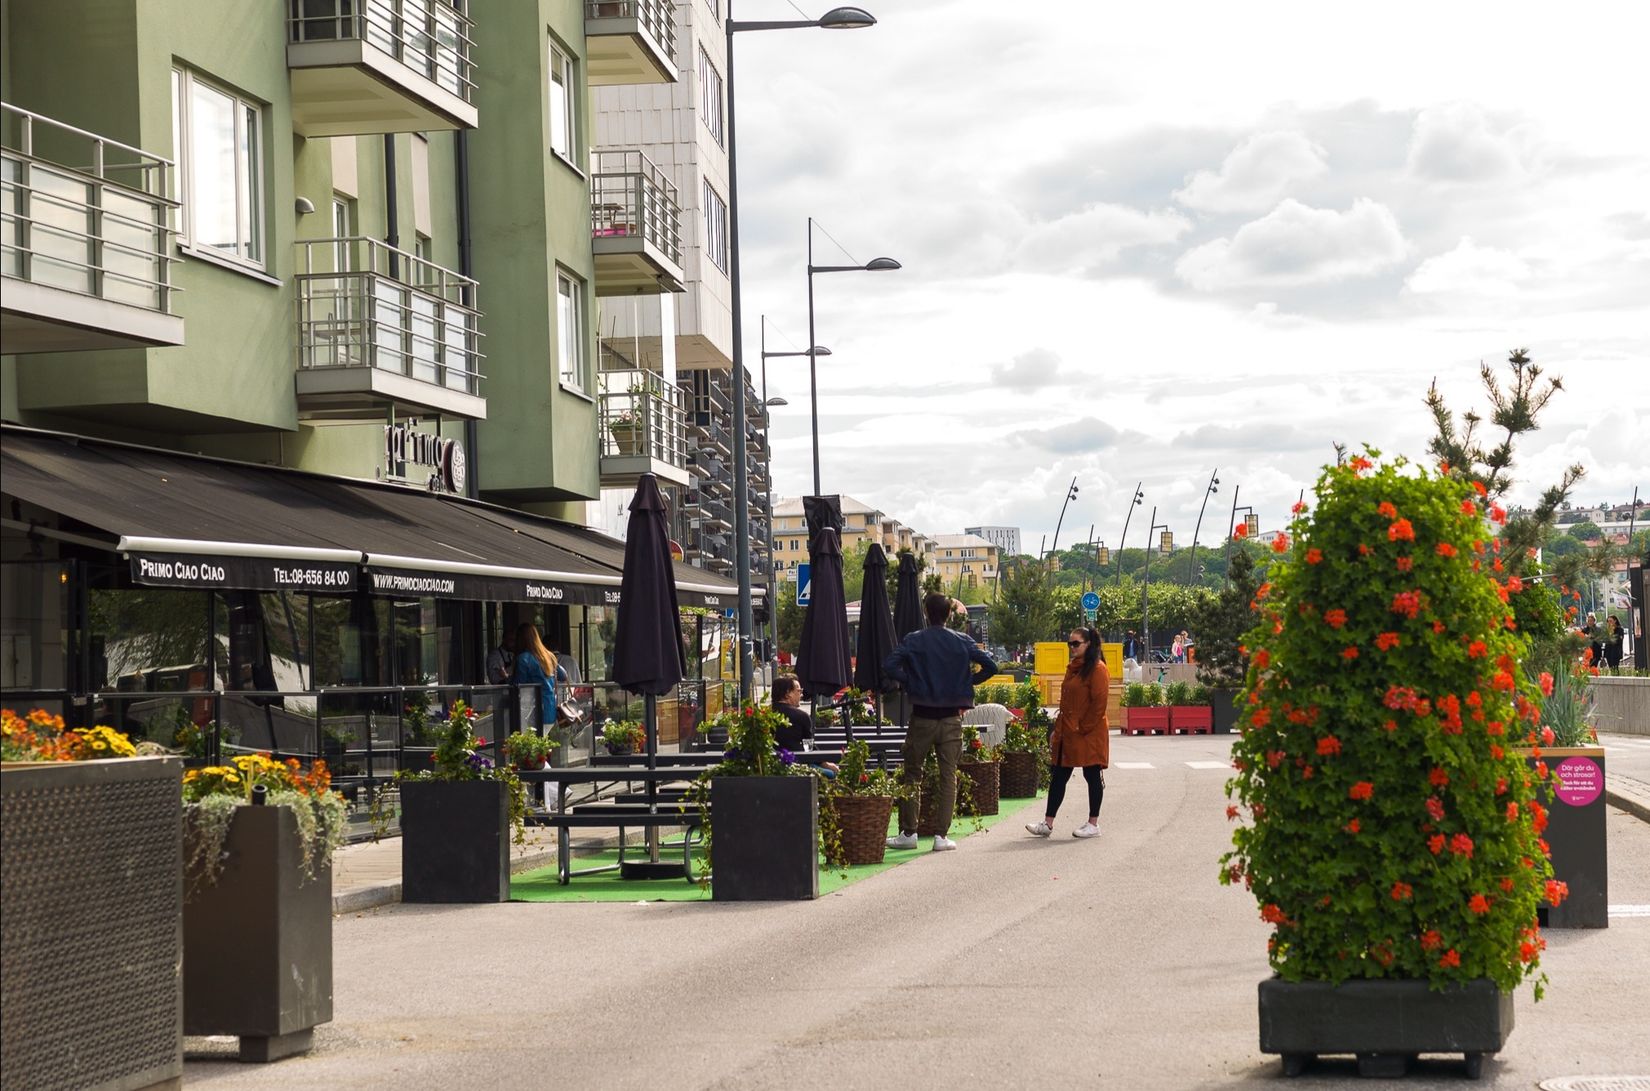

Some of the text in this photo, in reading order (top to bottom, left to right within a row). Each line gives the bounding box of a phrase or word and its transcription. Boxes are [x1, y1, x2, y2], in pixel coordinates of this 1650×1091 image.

[140, 558, 225, 582] PRIMO CIAO CIAO
[324, 569, 336, 586] 84
[336, 570, 350, 586] 00
